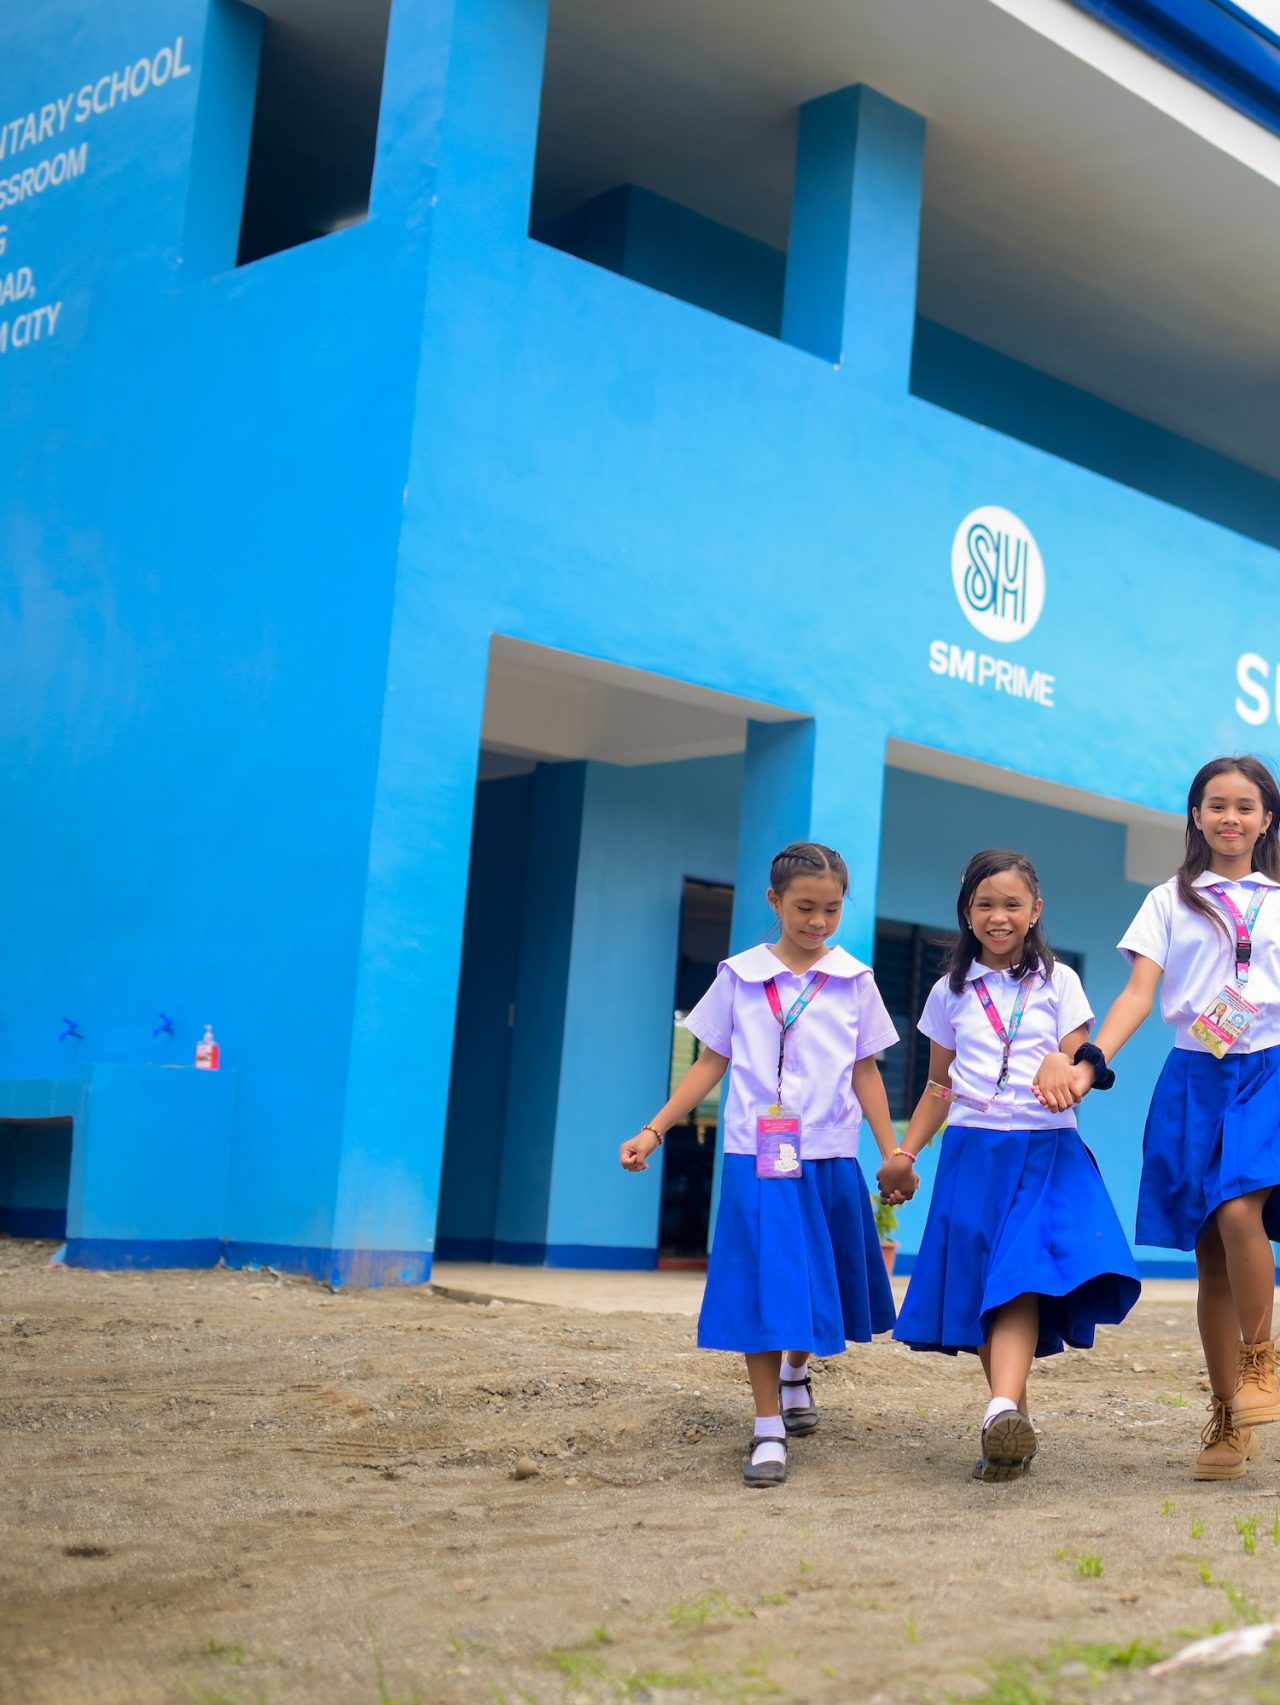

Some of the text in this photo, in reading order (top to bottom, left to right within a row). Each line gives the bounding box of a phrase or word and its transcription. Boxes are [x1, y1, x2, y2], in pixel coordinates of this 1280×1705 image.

[75, 36, 191, 123] SCHOOL
[0, 267, 36, 306] AD,
[12, 302, 62, 348] CITY
[928, 639, 1056, 708] SM PRIME
